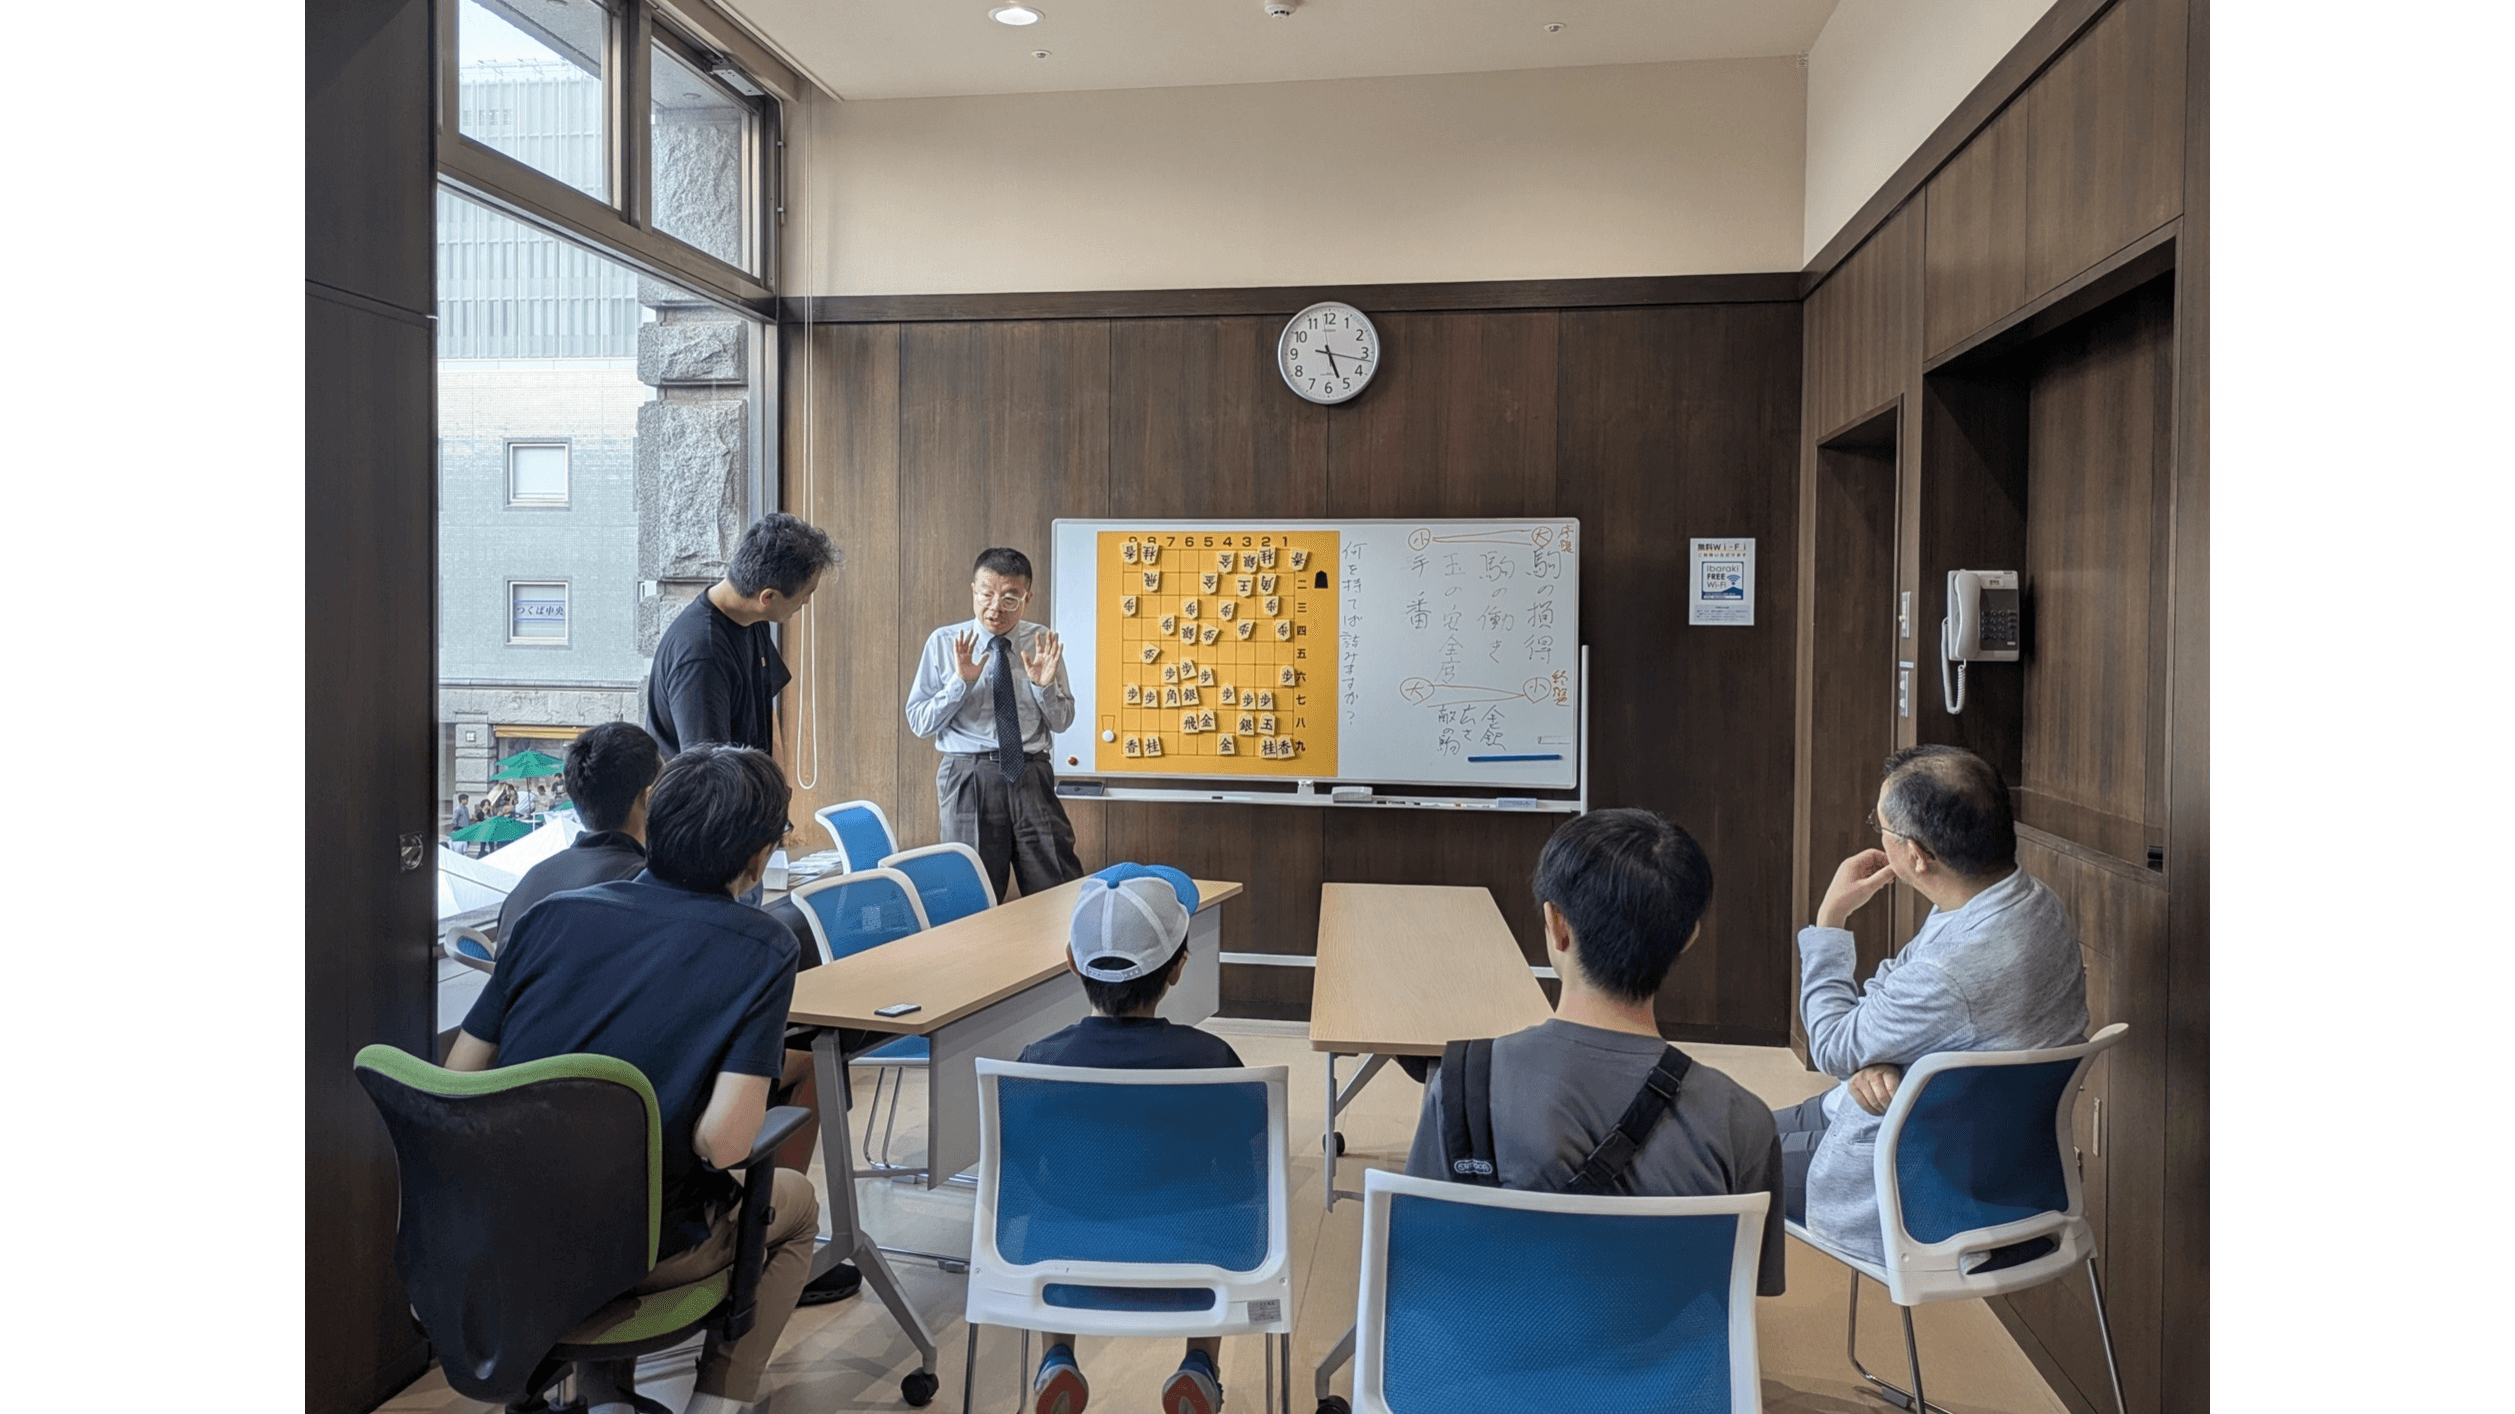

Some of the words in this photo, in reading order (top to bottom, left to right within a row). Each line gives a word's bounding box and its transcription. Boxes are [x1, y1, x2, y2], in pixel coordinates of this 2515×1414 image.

[1308, 318, 1318, 330] 11
[1323, 312, 1336, 325] 12
[1344, 317, 1349, 329] 1
[1294, 331, 1307, 343] 10
[1355, 329, 1364, 341] 2
[1290, 348, 1298, 360] 9
[1361, 347, 1369, 359] 3
[1295, 365, 1303, 377] 8
[1354, 365, 1363, 377] 4
[1308, 378, 1316, 390] 7
[1325, 382, 1333, 394] 6
[1342, 378, 1350, 389] 5
[1166, 536, 1176, 547] 7
[1185, 536, 1194, 547] 6
[1204, 536, 1213, 547] 5
[1222, 536, 1232, 547] 4
[1242, 536, 1252, 547] 3
[1261, 536, 1271, 547] 2
[1282, 536, 1288, 547] 1
[1297, 580, 1307, 589] 二
[1406, 554, 1432, 629] 手番
[516, 606, 564, 616] つくば中央
[1297, 602, 1307, 613] 三
[1477, 550, 1516, 664] 駒の働き
[1523, 550, 1561, 664] 駒の損得
[1434, 552, 1466, 684] 玉の安全度
[1297, 626, 1307, 636] 四
[1296, 649, 1307, 659] 五
[1165, 666, 1176, 680] 歩
[1181, 661, 1193, 676] 歩
[1200, 669, 1211, 684] 歩
[1281, 669, 1293, 683] 歩
[1296, 671, 1306, 682] 六
[1127, 687, 1138, 701] 歩
[1145, 691, 1156, 705] 歩
[1165, 688, 1177, 704] 角
[1182, 688, 1197, 702] 銀
[1222, 687, 1233, 701] 歩
[1242, 693, 1254, 707] 歩
[1260, 693, 1271, 707] 歩
[1296, 694, 1306, 706] 七
[1184, 716, 1197, 730] 飛
[1200, 714, 1213, 728] 金
[1240, 718, 1252, 732] 銀
[1296, 717, 1306, 728] 八
[1126, 739, 1138, 753] 香
[1146, 739, 1159, 754] 桂
[1219, 738, 1232, 752] 金
[1262, 740, 1275, 755] 桂
[1279, 740, 1291, 754] 香
[1295, 741, 1306, 752] 九
